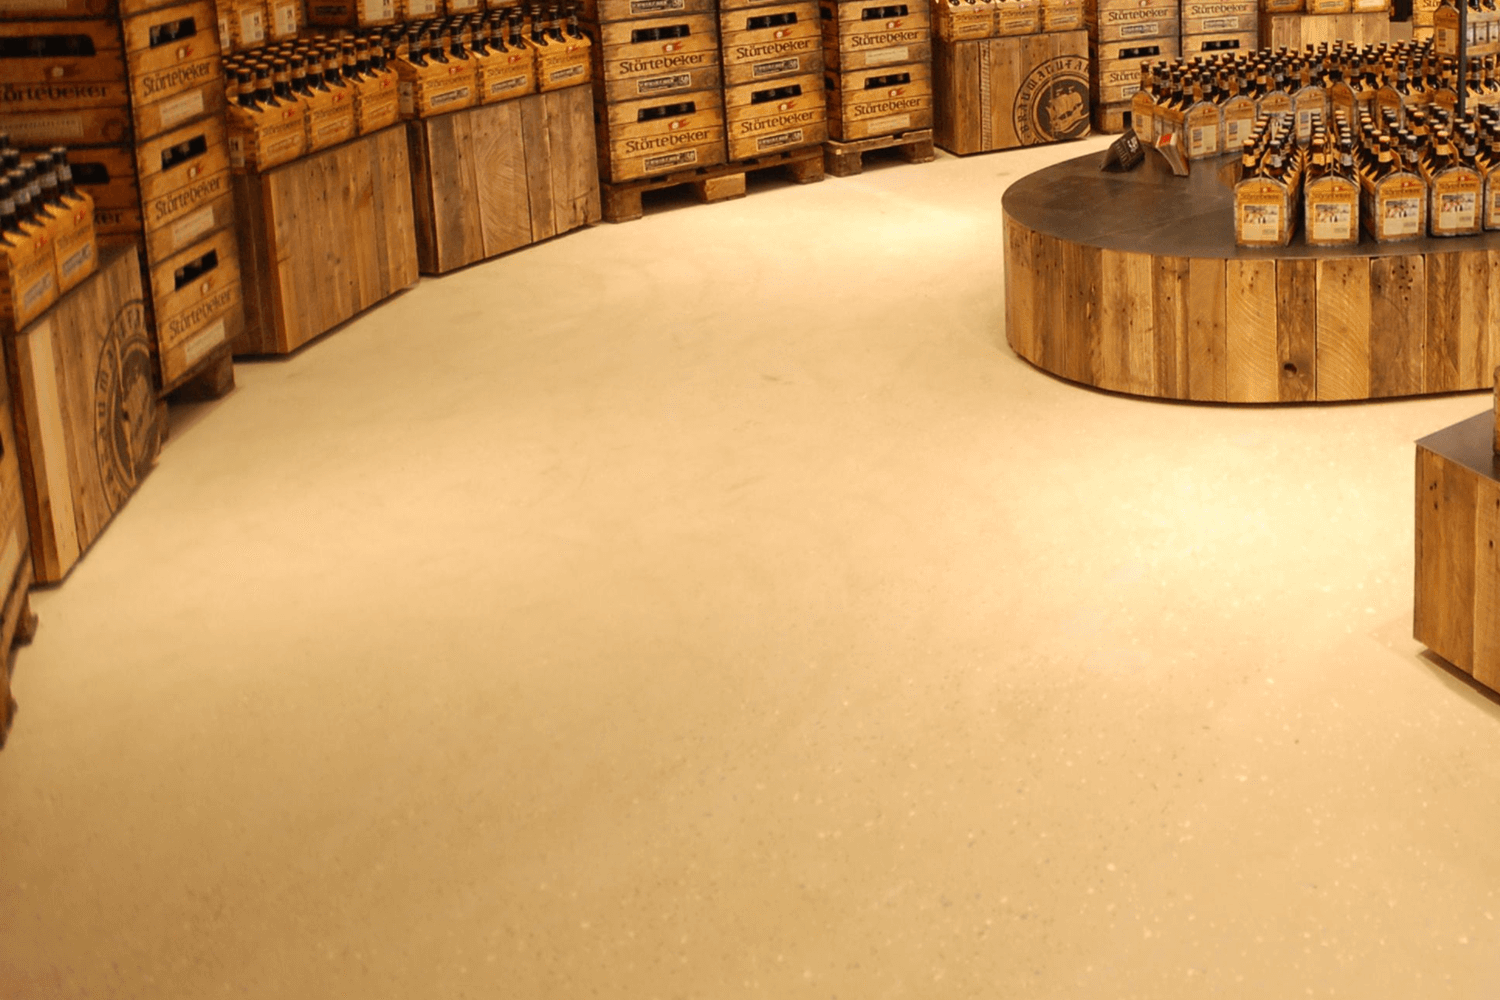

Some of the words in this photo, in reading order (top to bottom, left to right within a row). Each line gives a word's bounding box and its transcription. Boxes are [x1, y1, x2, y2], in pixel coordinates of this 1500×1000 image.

[1108, 7, 1169, 22] Störtebeker
[1191, 2, 1251, 16] Störtebeker
[736, 38, 810, 60] Störtebeker
[851, 29, 920, 48] Störtebeker
[619, 53, 706, 75] Störtebeker
[142, 58, 211, 97] Störtebeker
[854, 96, 922, 117] Störtebeker
[740, 110, 815, 134] Störtebeker
[625, 129, 710, 154] Störtebeker
[155, 175, 222, 221] Störtebeker
[168, 289, 233, 342] Störtebeker
